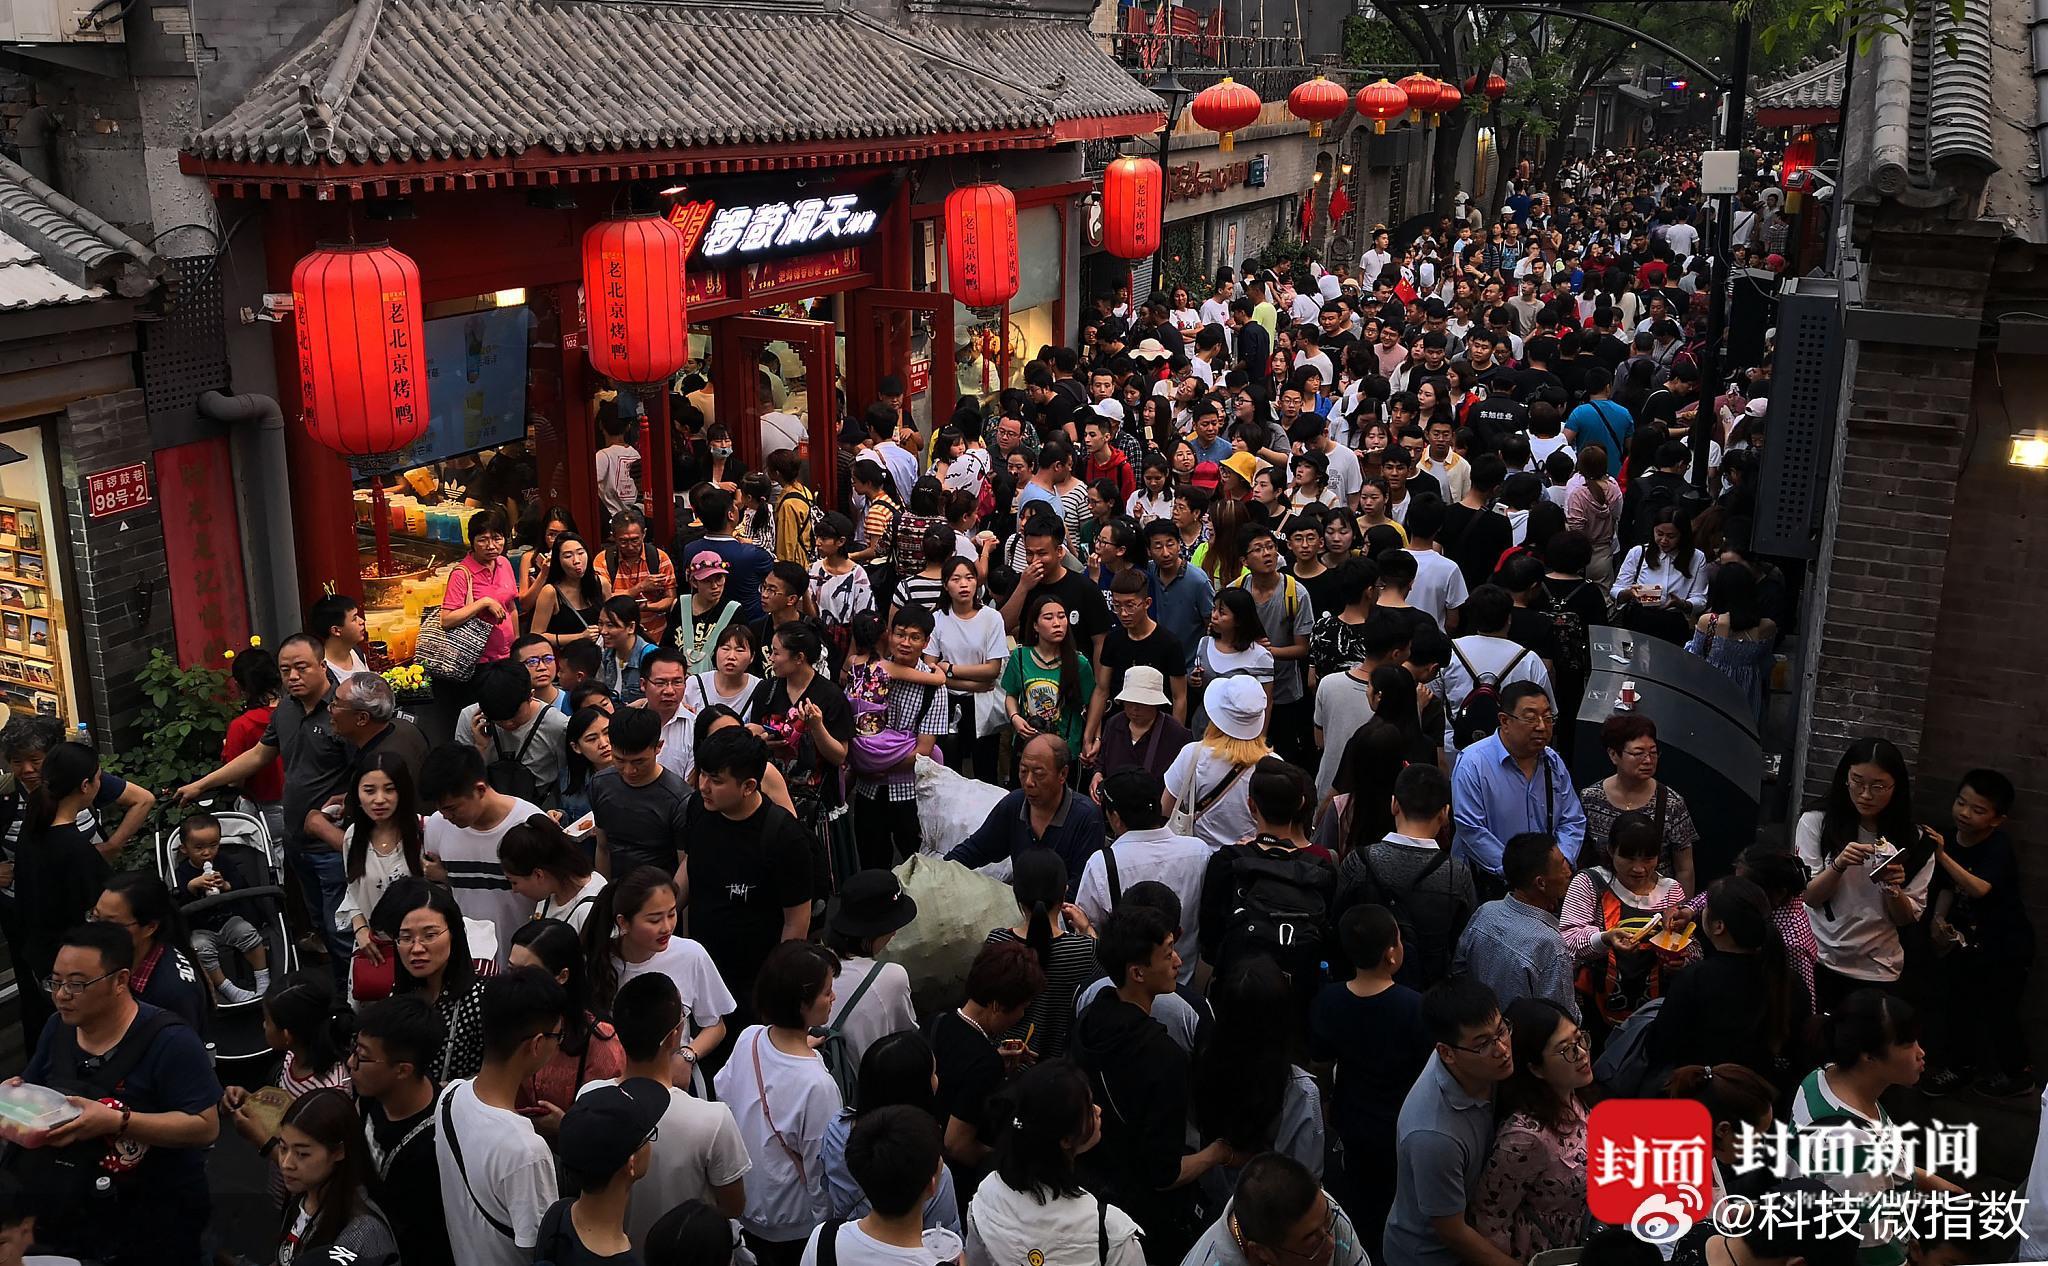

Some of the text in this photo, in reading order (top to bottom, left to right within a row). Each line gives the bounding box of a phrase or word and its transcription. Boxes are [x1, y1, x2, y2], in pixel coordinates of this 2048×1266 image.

[702, 194, 858, 257] 锣鼓洞天
[1135, 184, 1147, 245] 老北京烤鸭
[963, 216, 978, 291] 老北京烤鸭
[608, 261, 627, 360] 老北京烤鸭
[388, 303, 414, 425] 老北京烤鸭
[93, 469, 143, 492] 南锣鼓巷
[95, 485, 145, 511] 98号-2
